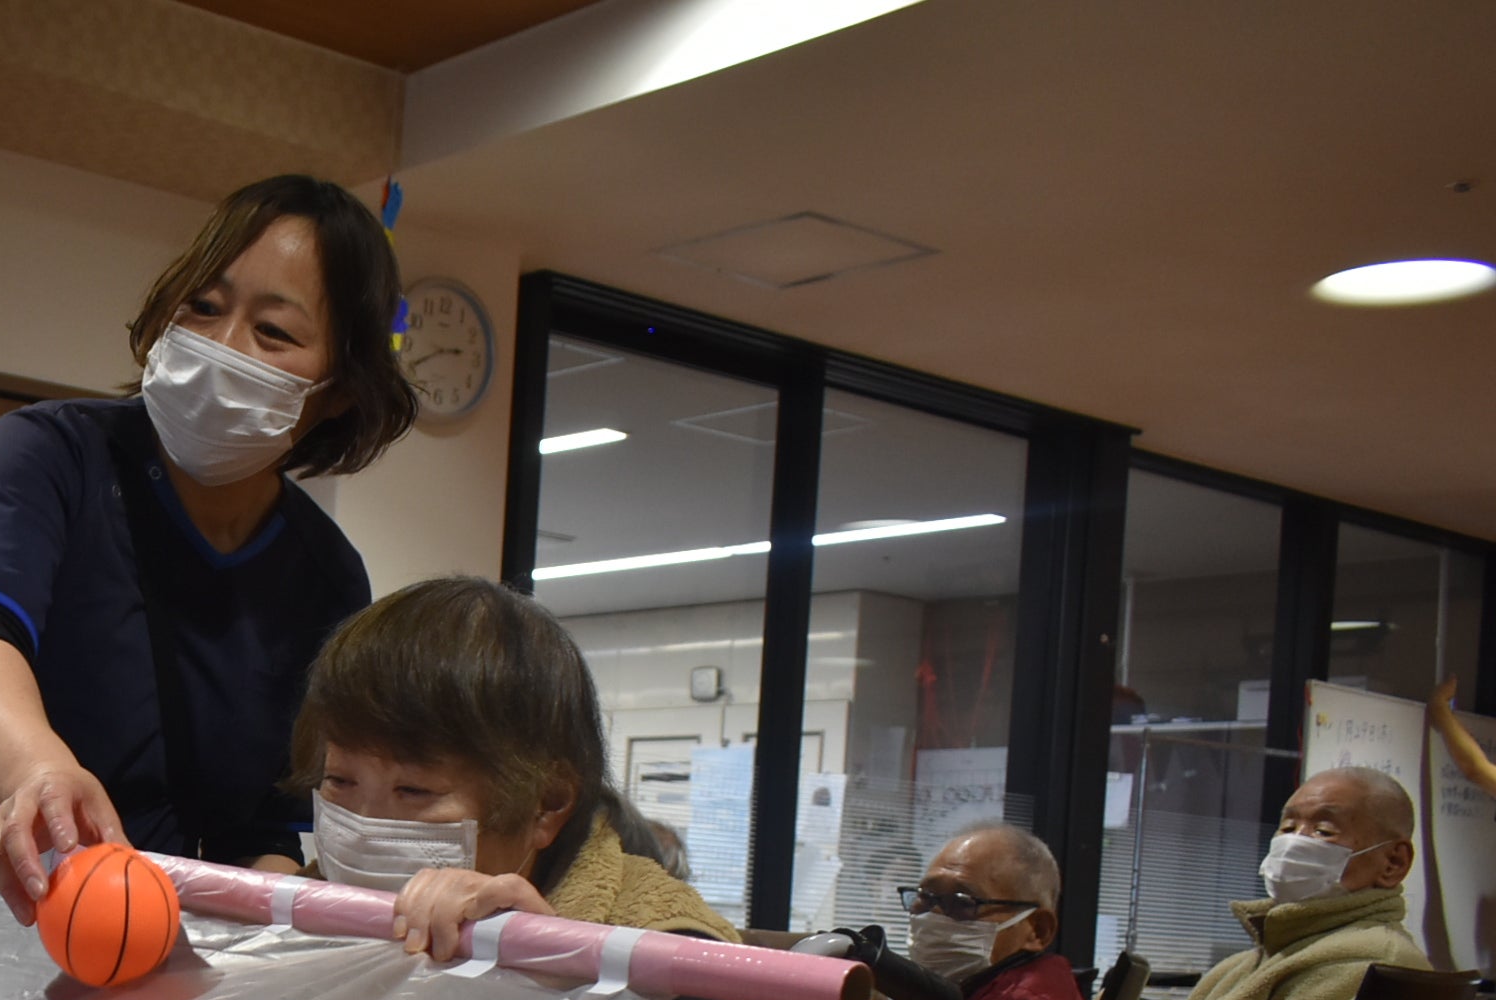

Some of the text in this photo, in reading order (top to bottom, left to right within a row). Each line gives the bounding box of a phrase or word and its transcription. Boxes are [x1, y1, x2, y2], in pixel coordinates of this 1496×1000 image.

[424, 298, 434, 316] 11
[440, 297, 453, 314] 12
[410, 313, 423, 330] 10
[433, 388, 443, 406] 6
